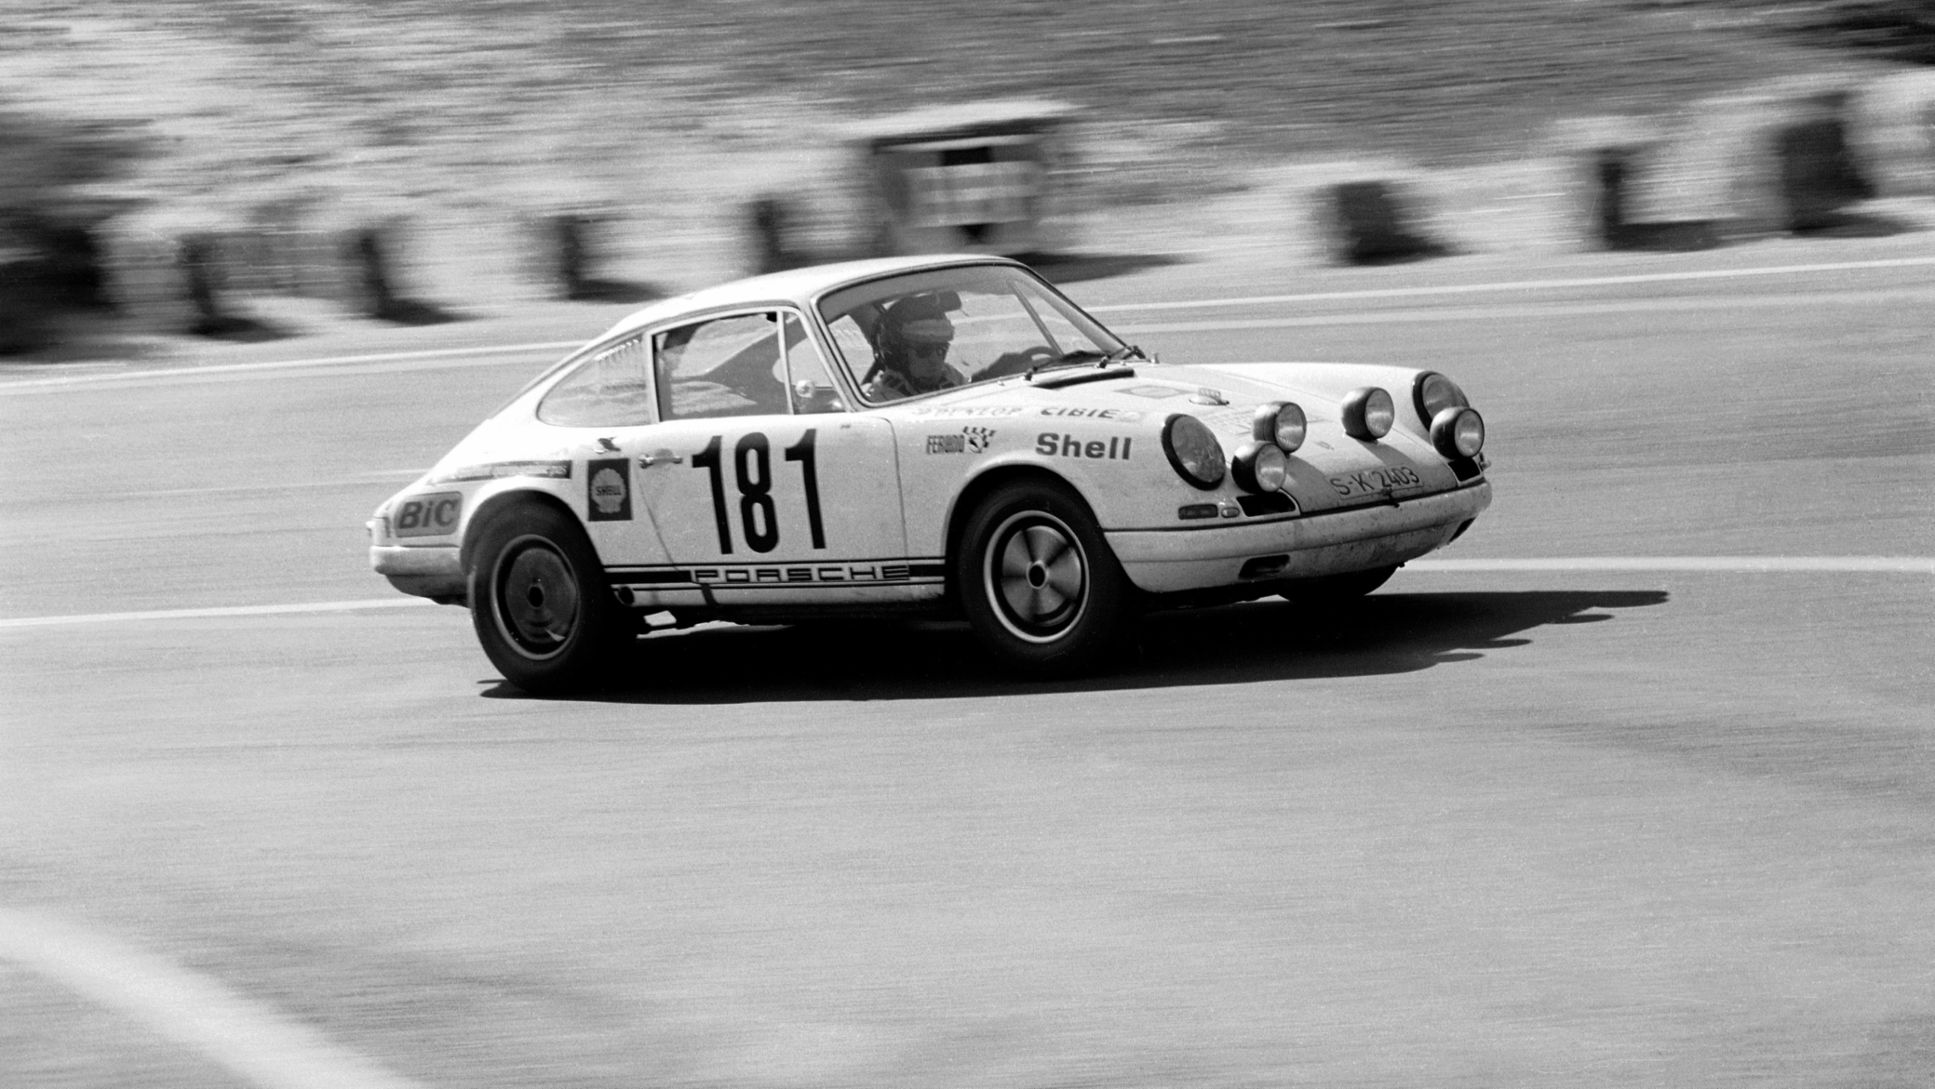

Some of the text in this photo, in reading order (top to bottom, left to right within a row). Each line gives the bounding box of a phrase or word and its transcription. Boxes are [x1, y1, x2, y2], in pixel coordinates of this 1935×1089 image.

[1035, 432, 1132, 460] Shell
[691, 428, 827, 555] 181
[692, 565, 911, 584] PORSCHE
